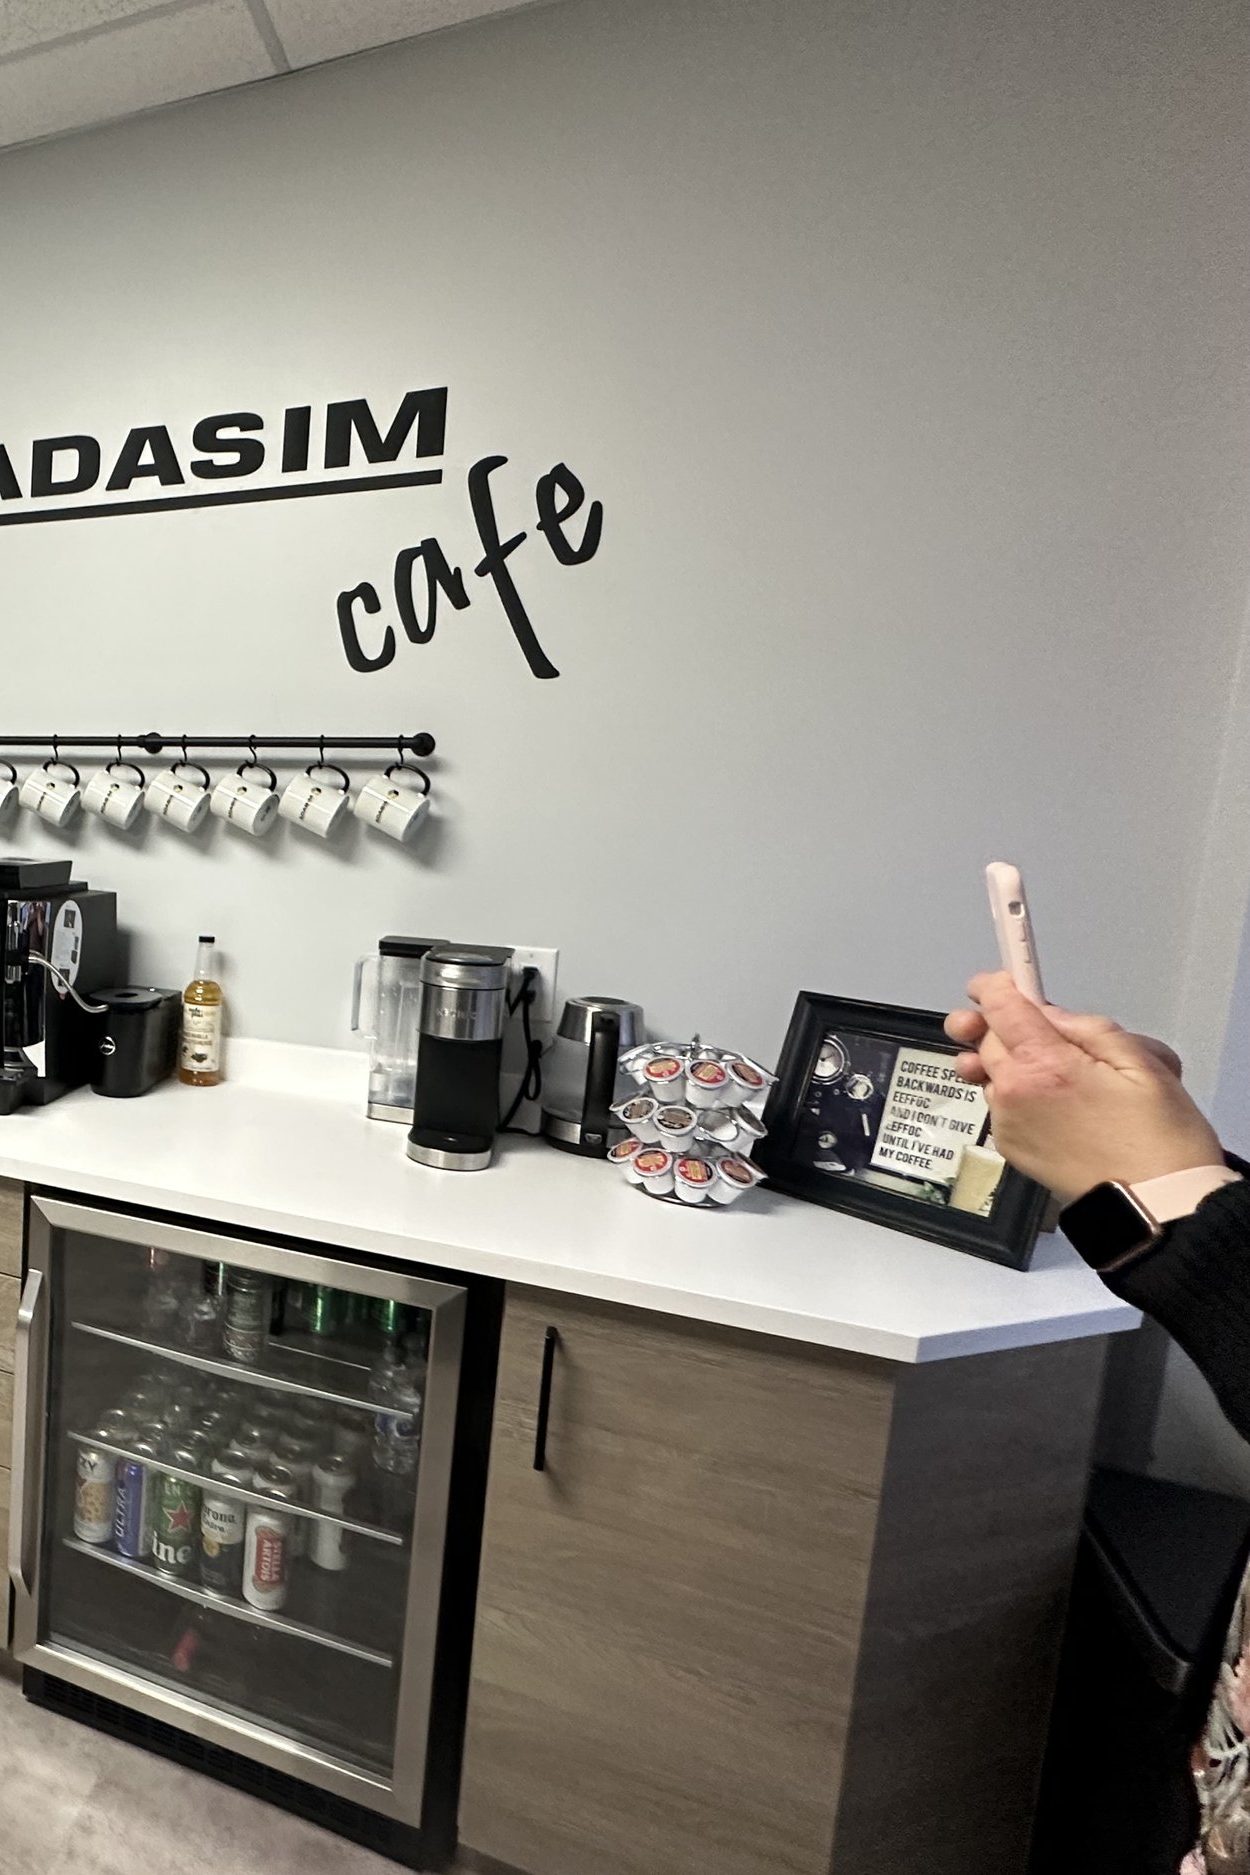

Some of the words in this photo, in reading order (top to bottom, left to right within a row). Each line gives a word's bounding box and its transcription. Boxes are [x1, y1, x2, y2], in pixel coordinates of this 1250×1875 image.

[337, 455, 602, 679] cafe
[901, 1061, 940, 1079] COFFEE
[893, 1091, 931, 1109] EEFFOC
[896, 1077, 964, 1099] BACKWARDS
[964, 1090, 977, 1102] IS
[890, 1106, 911, 1120] AND
[948, 1120, 976, 1135] GIVE
[879, 1147, 895, 1159] MY
[882, 1133, 910, 1150] UNTIL
[910, 1140, 931, 1155] I'VE
[932, 1146, 955, 1160] HAD
[116, 1487, 127, 1538] ULTRA
[260, 1539, 272, 1581] ARTOIS
